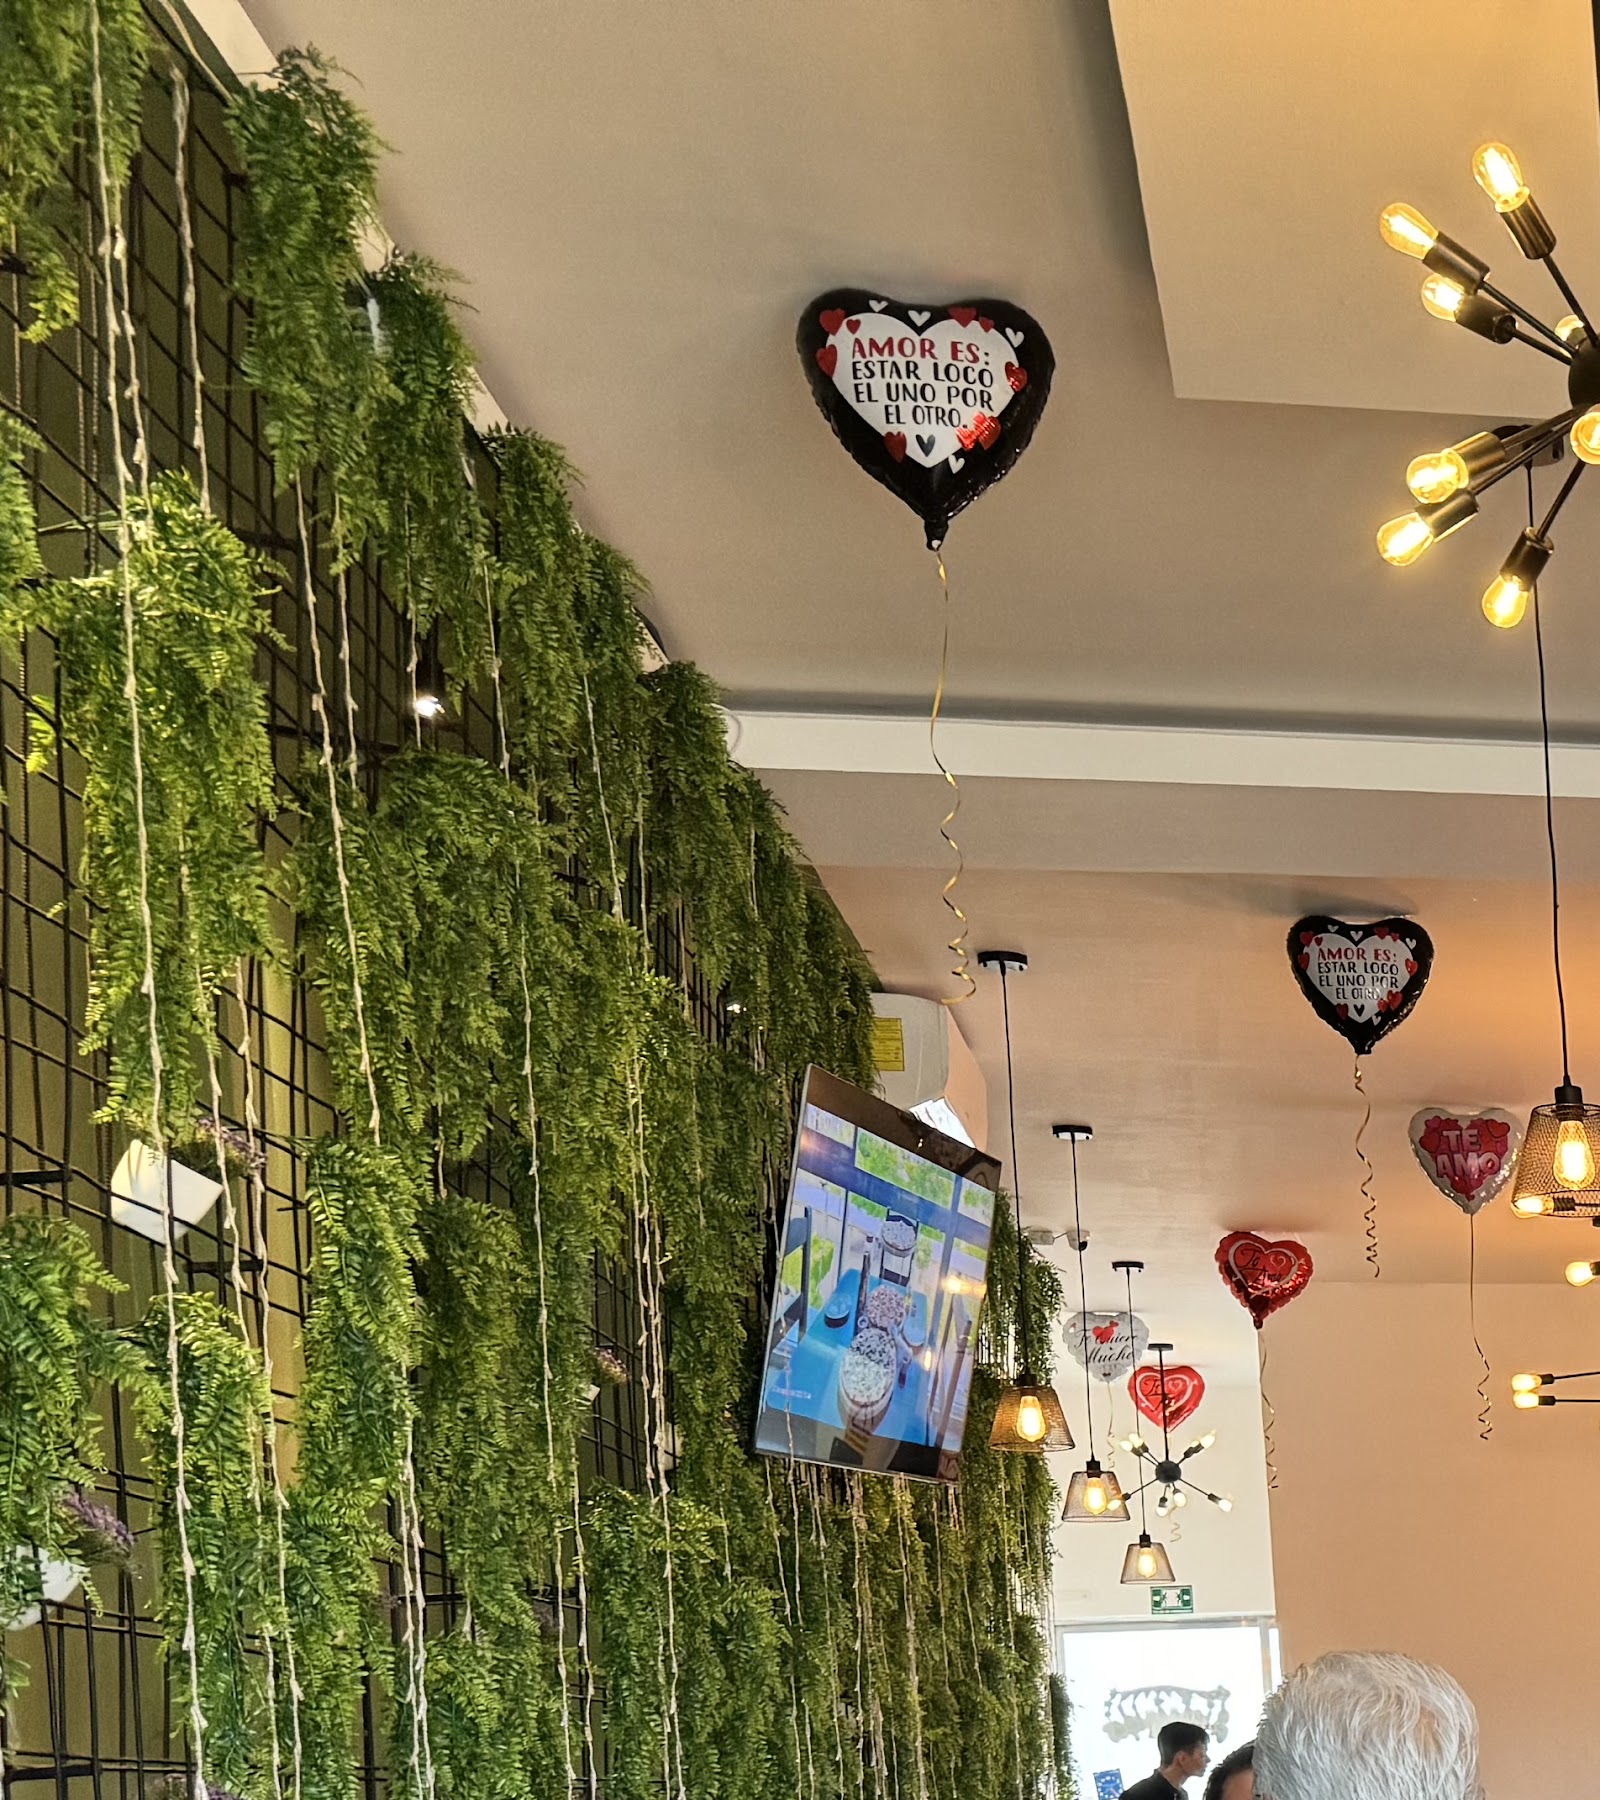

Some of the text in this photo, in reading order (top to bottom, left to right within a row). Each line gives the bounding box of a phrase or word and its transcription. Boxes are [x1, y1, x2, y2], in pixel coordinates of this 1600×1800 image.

[852, 337, 990, 366] AMOR ES:
[852, 360, 993, 388] ESTAR LOCO
[855, 383, 994, 412] EL UNO POR
[885, 406, 968, 428] EL OTRO.
[1318, 948, 1397, 962] AMOR ES:
[1318, 962, 1399, 975] ESTAR LOCO
[1319, 976, 1399, 989] EL UNO POR
[1336, 988, 1347, 999] EL
[1441, 1129, 1481, 1152] TE
[1436, 1152, 1501, 1179] AMO
